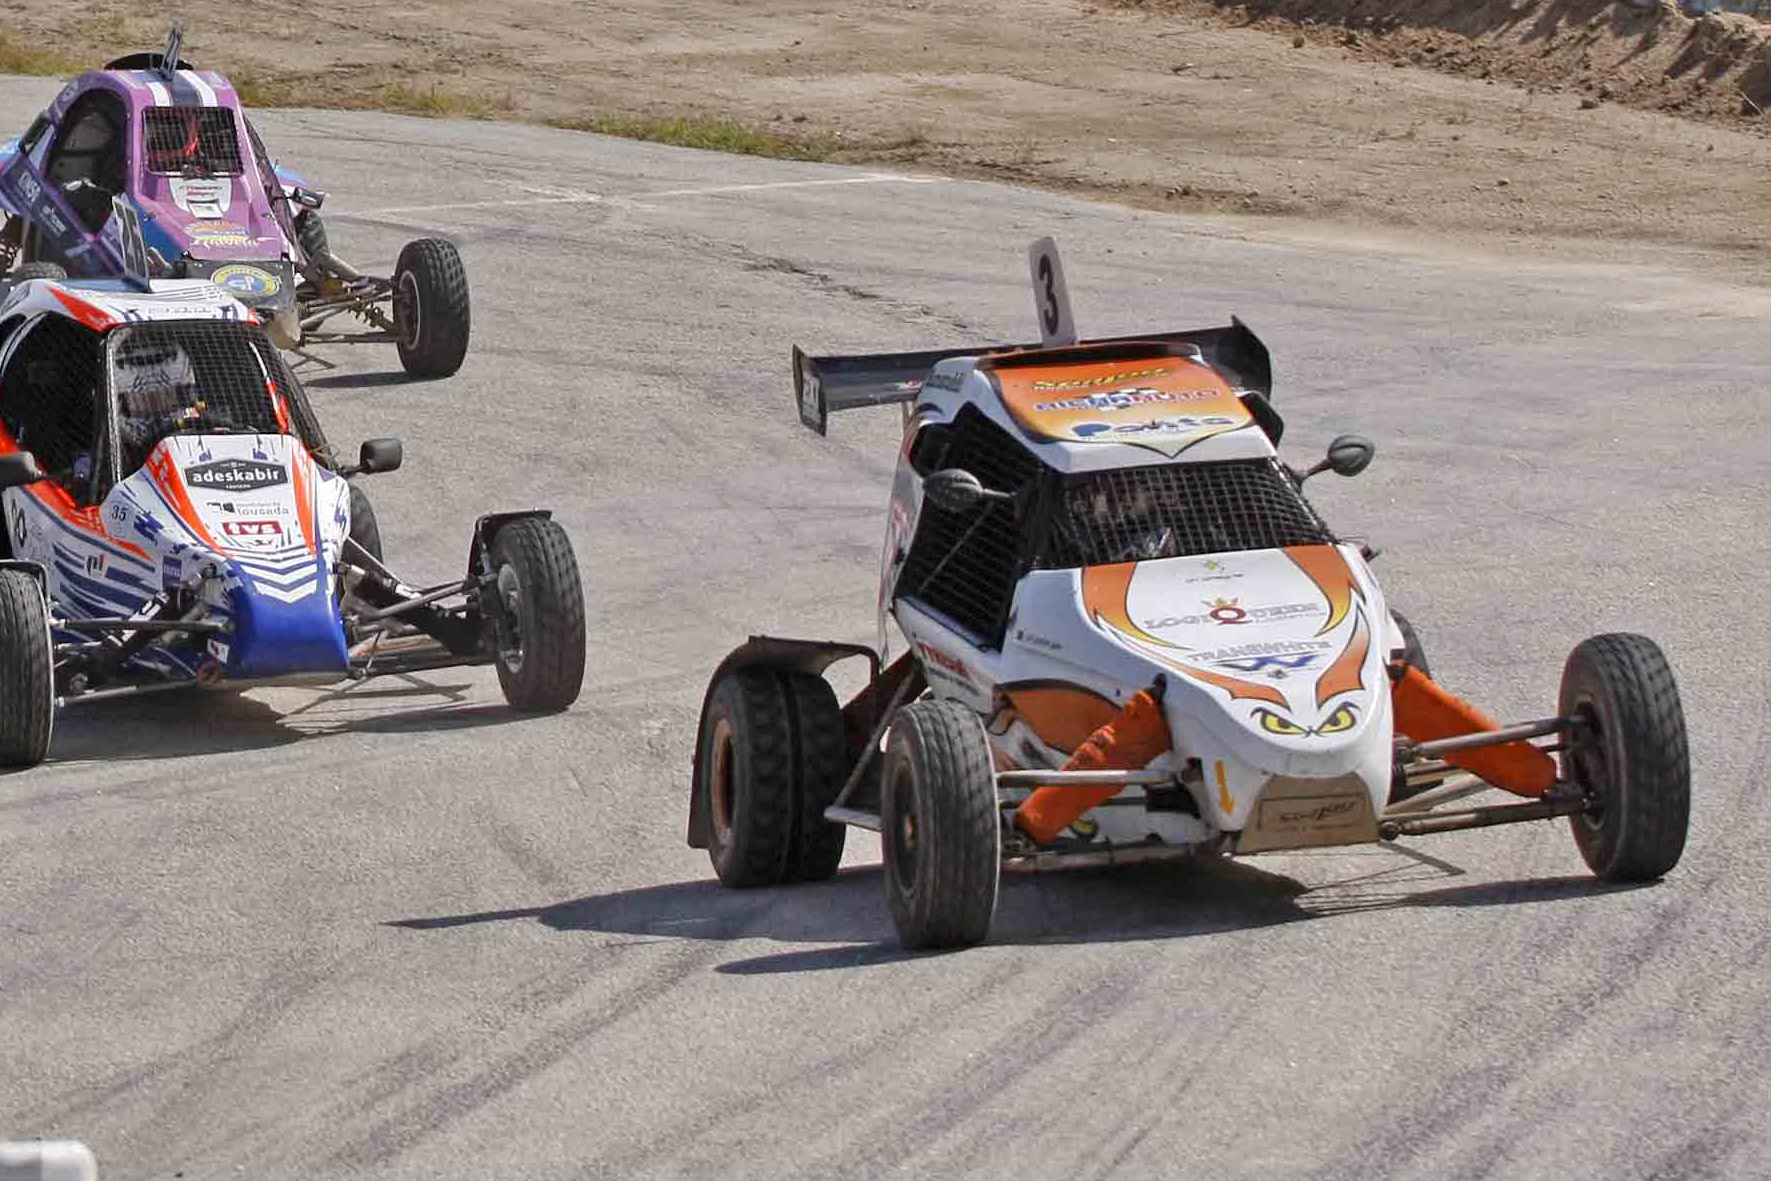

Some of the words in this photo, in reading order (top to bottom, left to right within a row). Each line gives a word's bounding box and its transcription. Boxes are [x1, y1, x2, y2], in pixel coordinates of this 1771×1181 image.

[1039, 253, 1059, 336] 3
[192, 468, 279, 484] adeskabir
[228, 522, 274, 535] tvs
